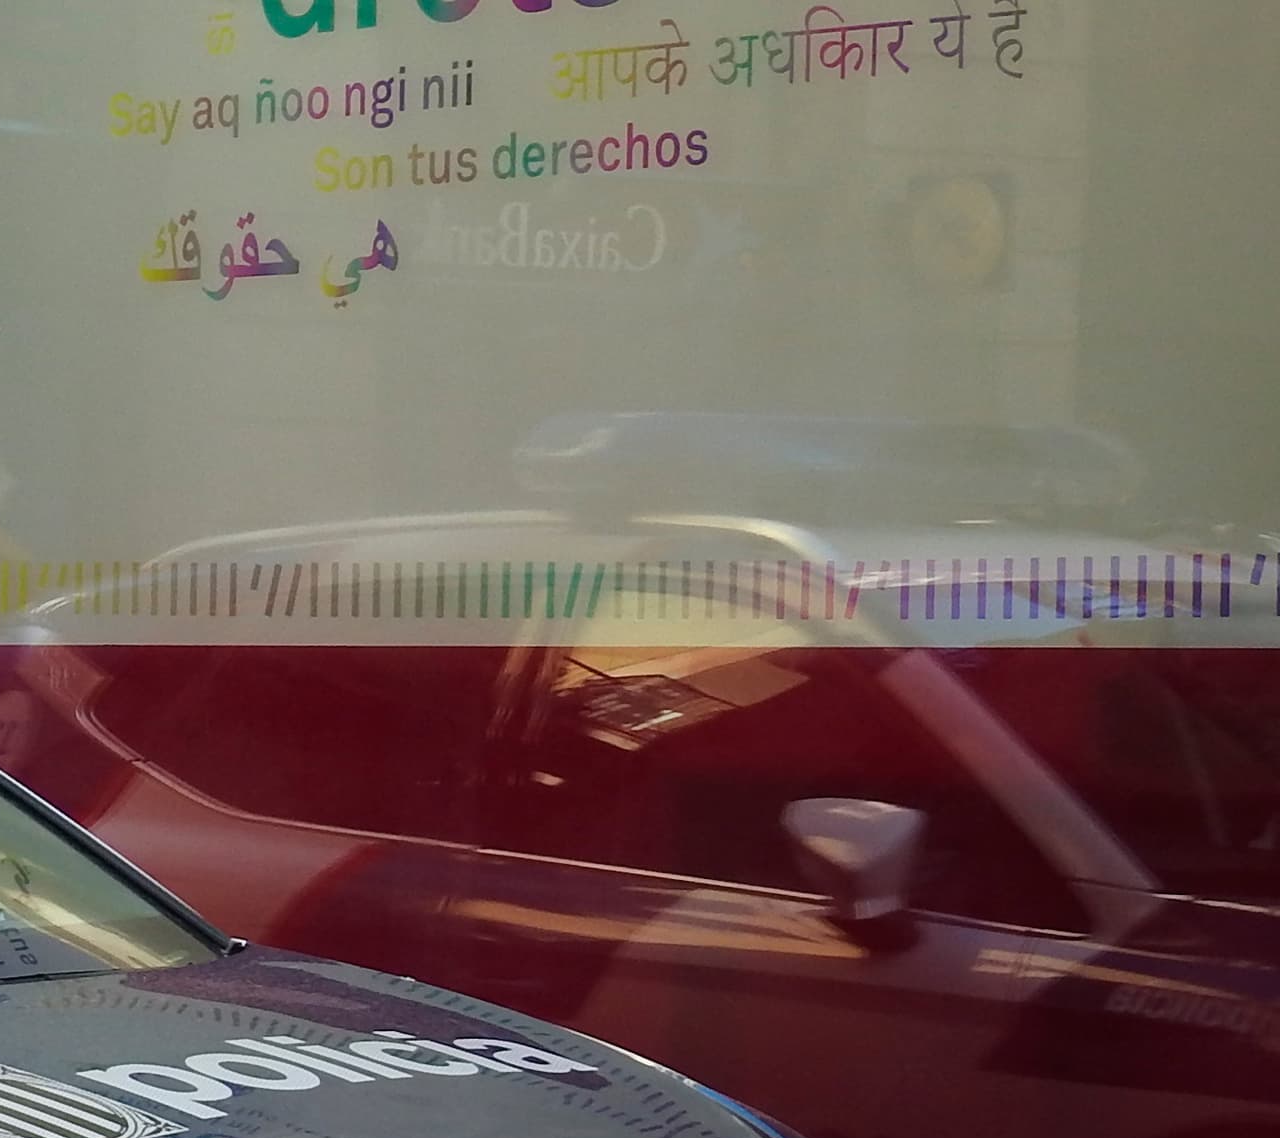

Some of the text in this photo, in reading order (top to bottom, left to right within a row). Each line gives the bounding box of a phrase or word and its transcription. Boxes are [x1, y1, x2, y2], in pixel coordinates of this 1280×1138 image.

[108, 59, 474, 145] Say aq ñoo ngi nii
[313, 122, 709, 192] Son tus derechos
[319, 218, 399, 310] هي
[76, 1030, 600, 1120] policia
